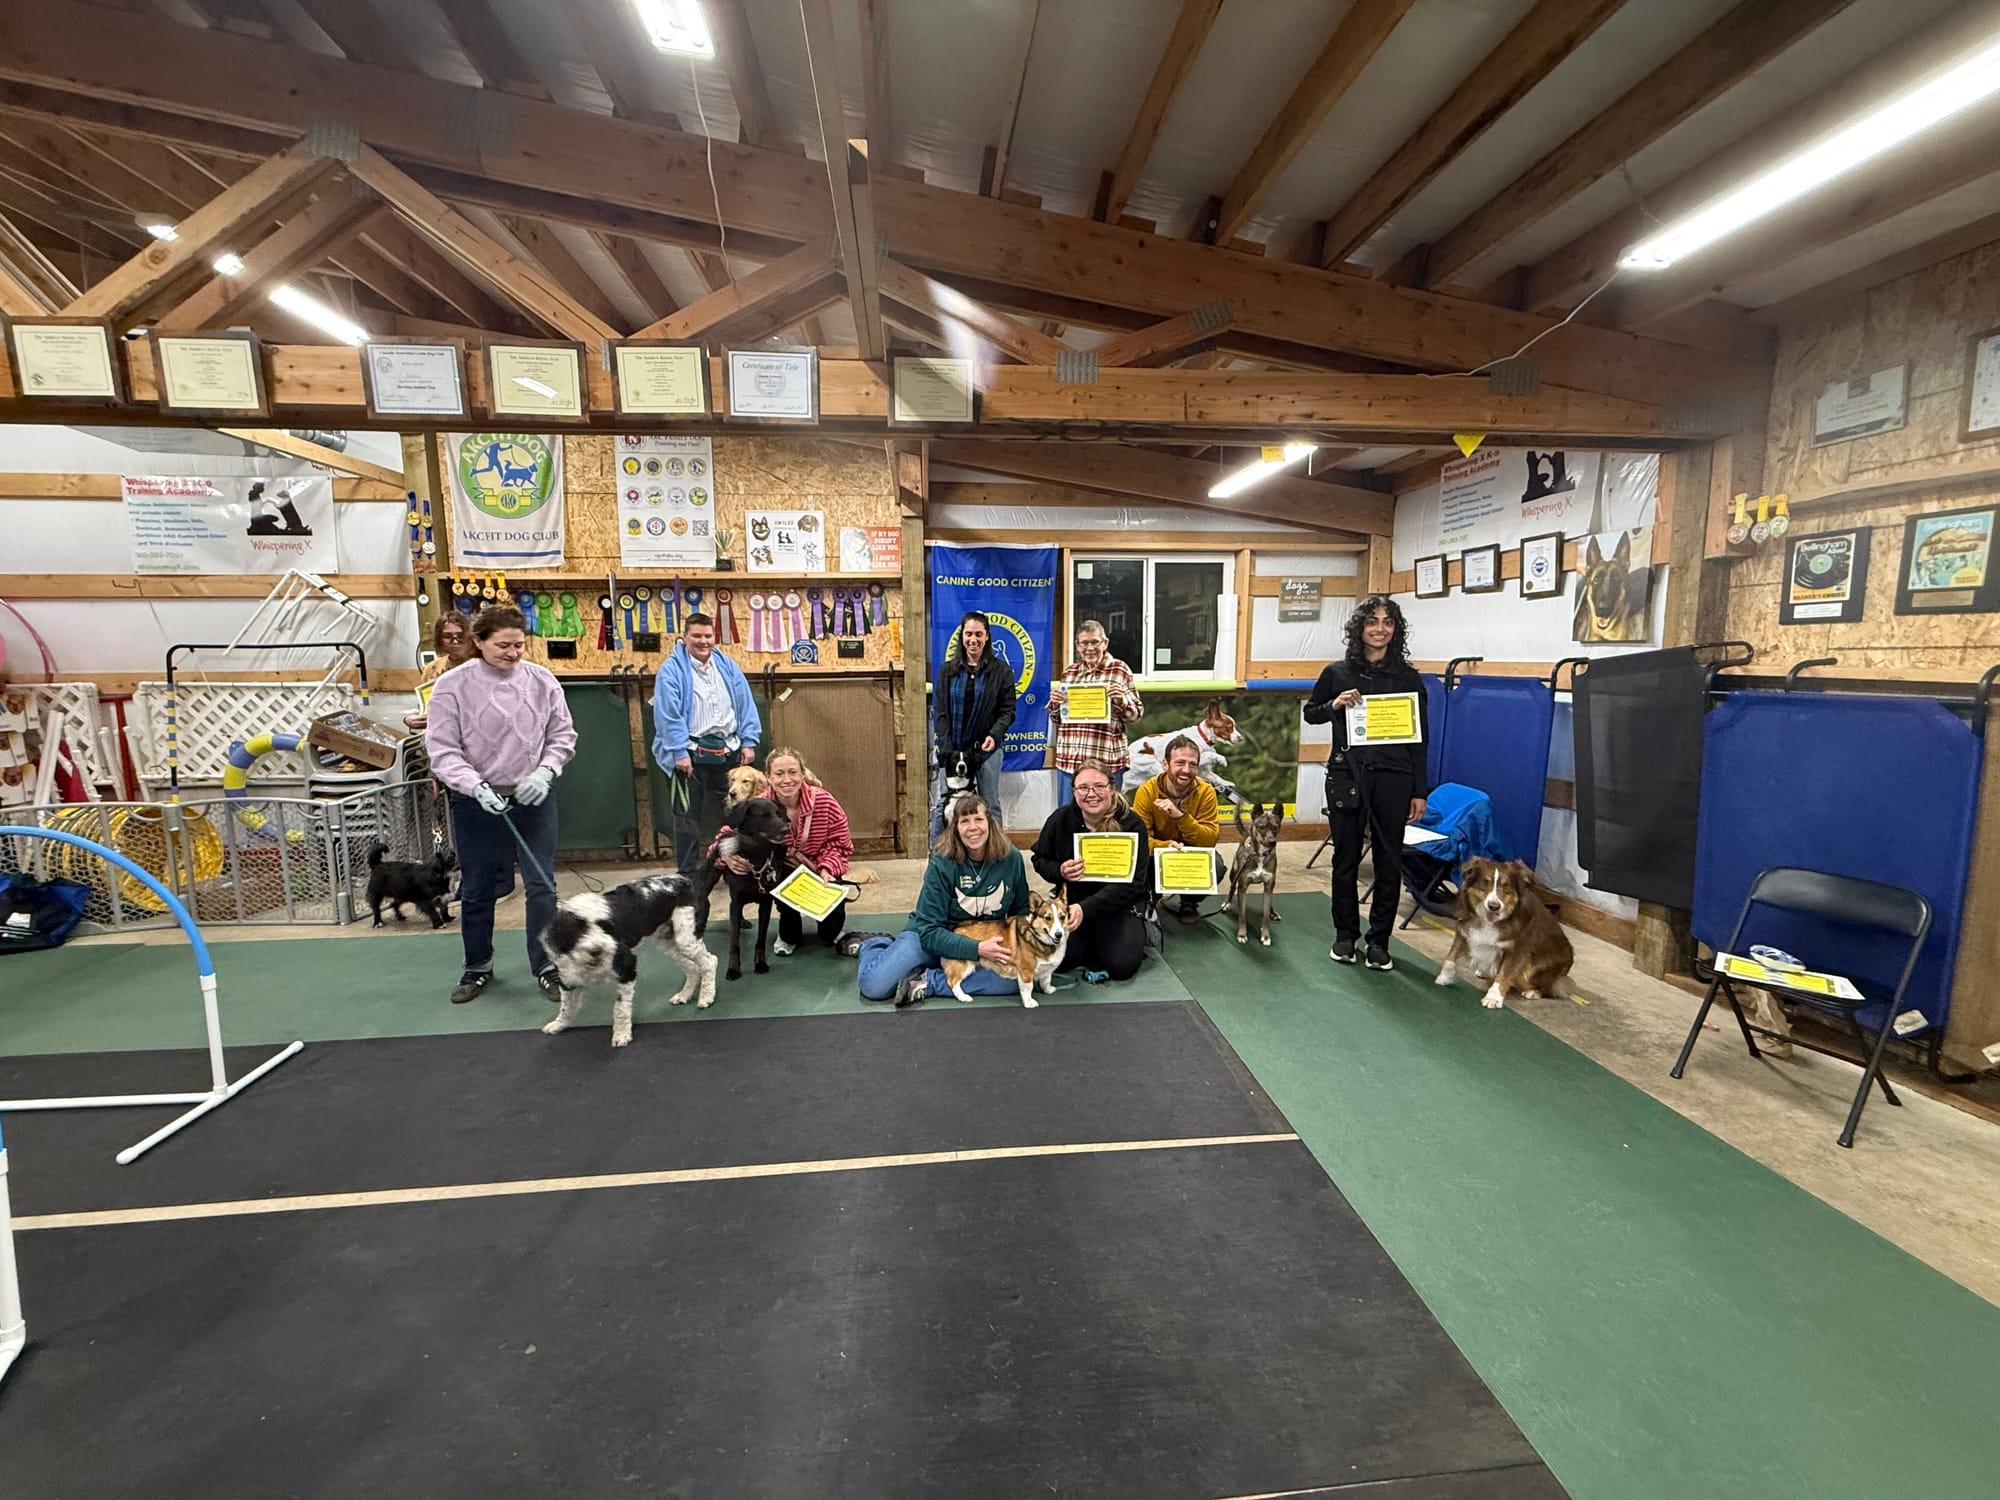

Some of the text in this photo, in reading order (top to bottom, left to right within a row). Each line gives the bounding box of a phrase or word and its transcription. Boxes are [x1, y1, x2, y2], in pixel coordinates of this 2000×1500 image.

[126, 487, 163, 496] Training
[504, 532, 530, 541] DOG
[532, 531, 559, 541] CLUB
[1800, 541, 1848, 553] Bellingham
[936, 575, 1052, 588] CANINE GOOD CITIZEN
[1285, 578, 1310, 596] dogs
[990, 614, 1034, 671] OD CITIZEN
[1020, 743, 1048, 752] DOGS
